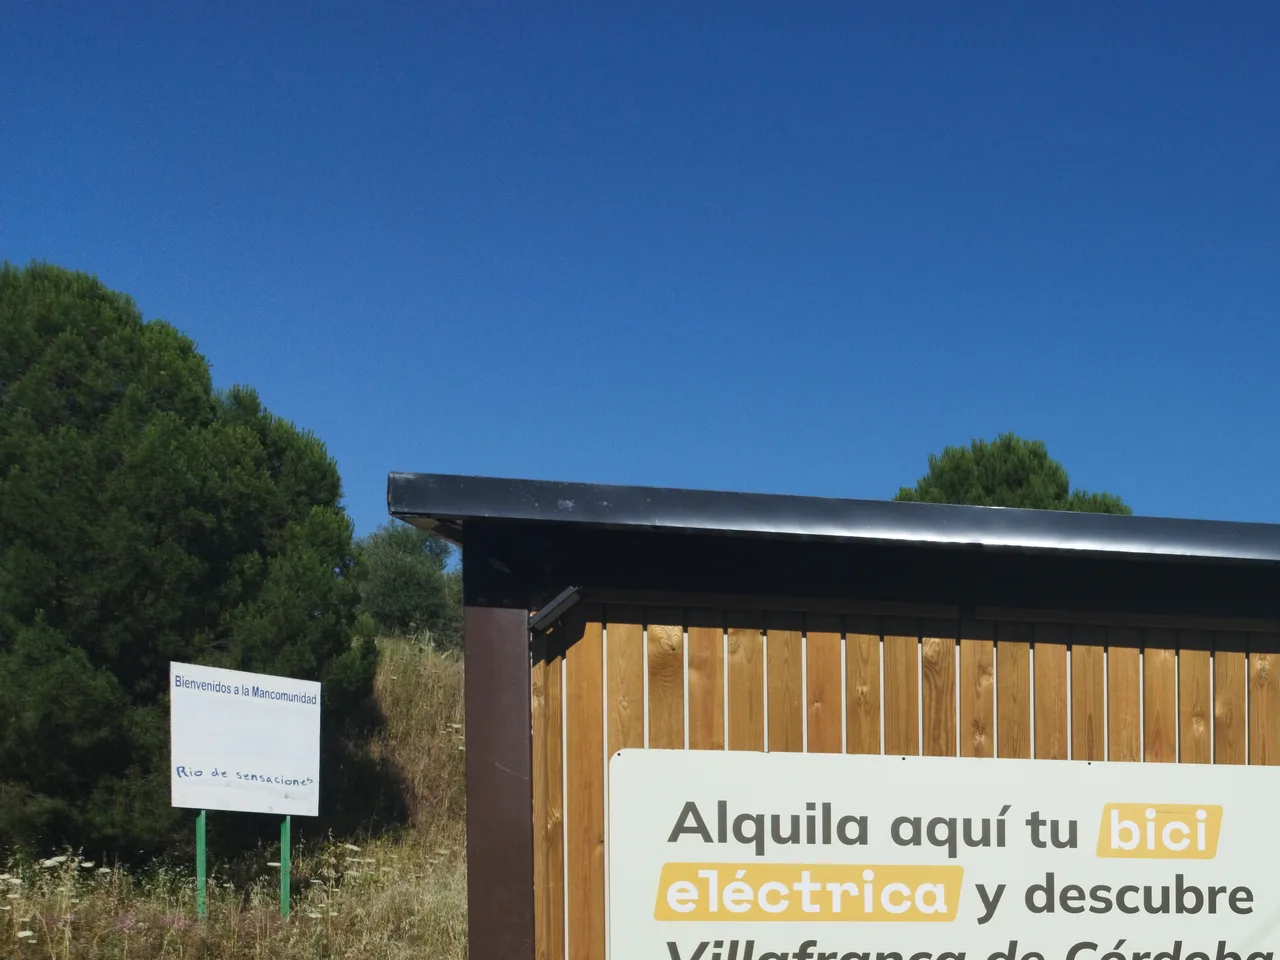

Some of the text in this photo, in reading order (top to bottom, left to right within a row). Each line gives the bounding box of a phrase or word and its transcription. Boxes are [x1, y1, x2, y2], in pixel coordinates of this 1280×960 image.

[175, 675, 317, 705] Bienvenidos a la Mancomunidad
[176, 766, 313, 786] Rio de sensaciones
[667, 800, 1207, 859] Alquila aquí tu bici
[667, 869, 1254, 925] eléctrica y descubre
